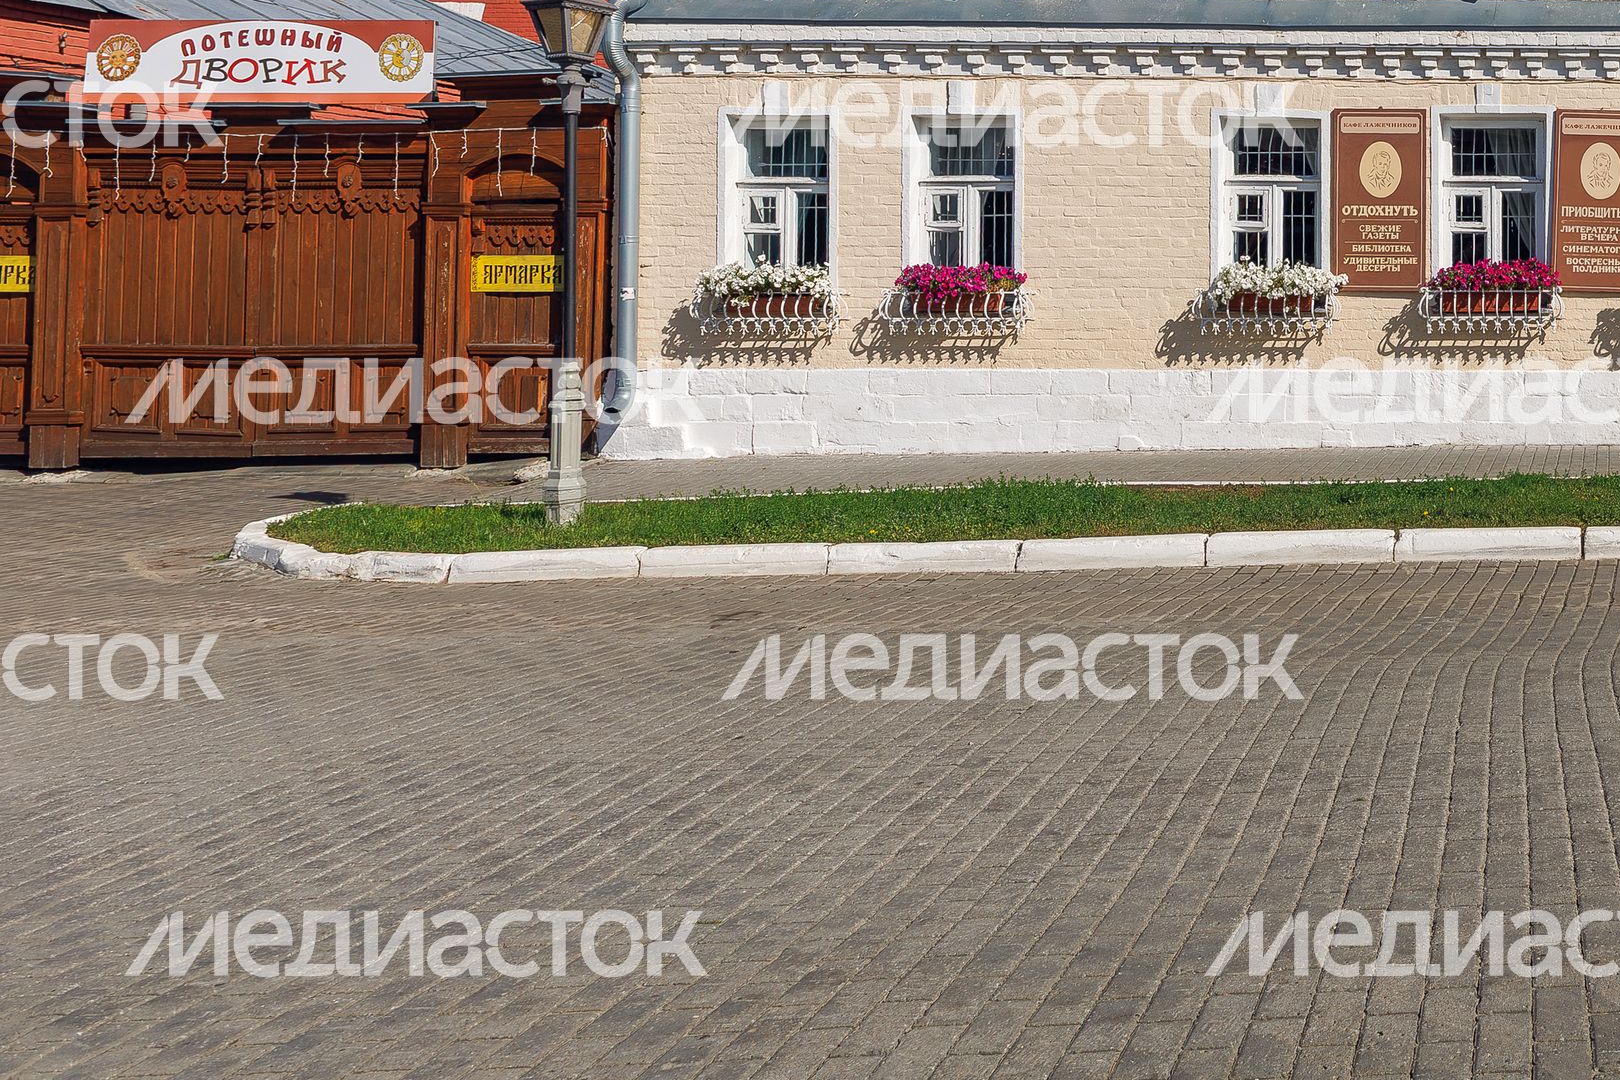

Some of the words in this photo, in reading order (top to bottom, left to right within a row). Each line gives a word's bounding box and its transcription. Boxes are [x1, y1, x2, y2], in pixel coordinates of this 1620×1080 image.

[181, 28, 343, 57] ПОТЕШНЫЙ
[169, 57, 348, 89] ДВОРИК
[1342, 206, 1418, 218] ОТДОХНУТЬ
[1362, 232, 1400, 240] ГАЗЕТЫ
[1580, 234, 1618, 242] ВЕЧЕРА
[1343, 256, 1418, 265] УДИВИТЕЛЬНЫЕ
[1356, 264, 1400, 272] ДЕСЕРТЫ
[0, 265, 36, 284] РКА
[483, 265, 562, 284] ЯРМАРКА
